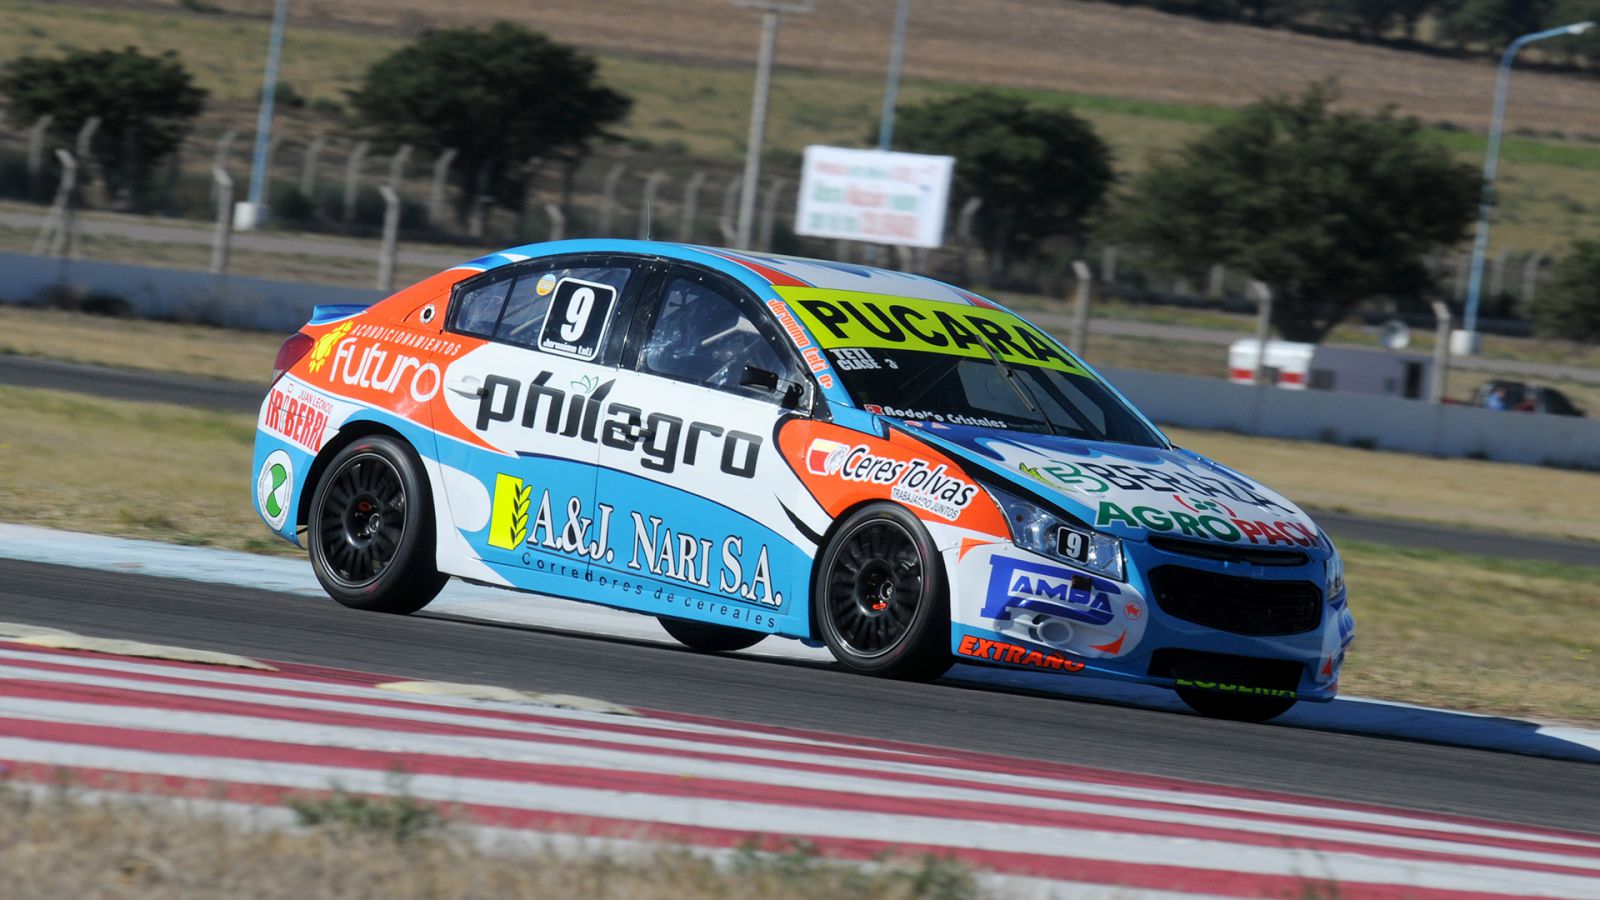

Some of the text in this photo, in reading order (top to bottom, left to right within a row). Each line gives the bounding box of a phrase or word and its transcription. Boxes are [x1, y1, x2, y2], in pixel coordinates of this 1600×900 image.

[560, 287, 595, 342] 9
[796, 300, 1075, 367] PUCARA
[350, 324, 462, 356] ACONDICIONAMIENTOS
[829, 348, 872, 360] TETI
[836, 358, 882, 371] CLASE
[476, 370, 763, 480] philagro
[929, 502, 959, 519] JUNTOS
[1066, 532, 1082, 558] 9
[521, 552, 775, 628] Corredores de cereales
[719, 535, 783, 606] S.A.
